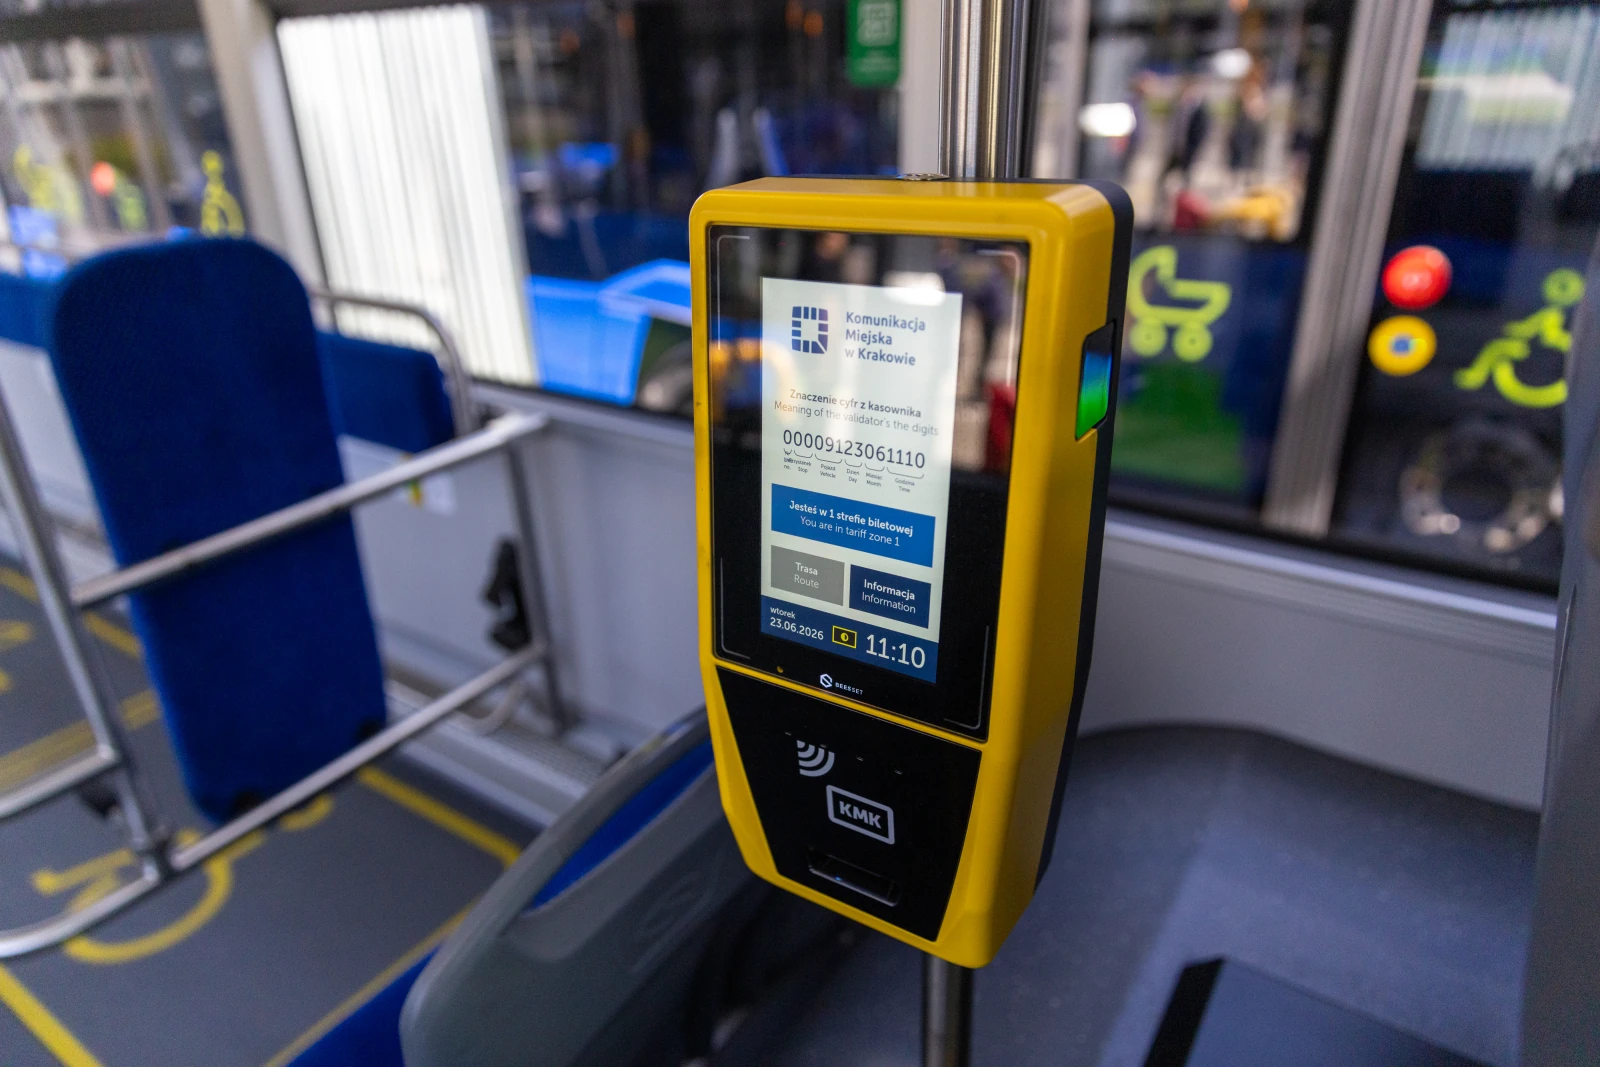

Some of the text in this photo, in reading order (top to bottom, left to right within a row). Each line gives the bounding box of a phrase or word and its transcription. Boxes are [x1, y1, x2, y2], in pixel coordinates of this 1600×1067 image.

[846, 312, 926, 333] Komunikacja
[846, 329, 892, 346] Miejska
[845, 348, 916, 366] w Krakowie
[790, 389, 837, 404] Znaczenie
[839, 398, 858, 409] cyfr
[868, 401, 922, 418] kasownika
[774, 401, 939, 436] Meaning of the validator's the digits
[784, 430, 925, 468] 00009123061110
[895, 478, 915, 486] Godzina
[790, 500, 817, 514] Jesteś
[830, 509, 834, 518] 1
[837, 511, 866, 525] strefie
[868, 517, 914, 538] biletowej
[800, 516, 900, 546] You are in tariff zone 1
[795, 562, 818, 576] Trasa
[794, 574, 819, 589] Route
[864, 579, 915, 601] Informacja
[770, 606, 796, 619] wtorek
[862, 592, 916, 614] Information
[770, 617, 824, 640] 23.06.2026
[866, 634, 926, 669] 11:10
[840, 801, 882, 829] KMK
